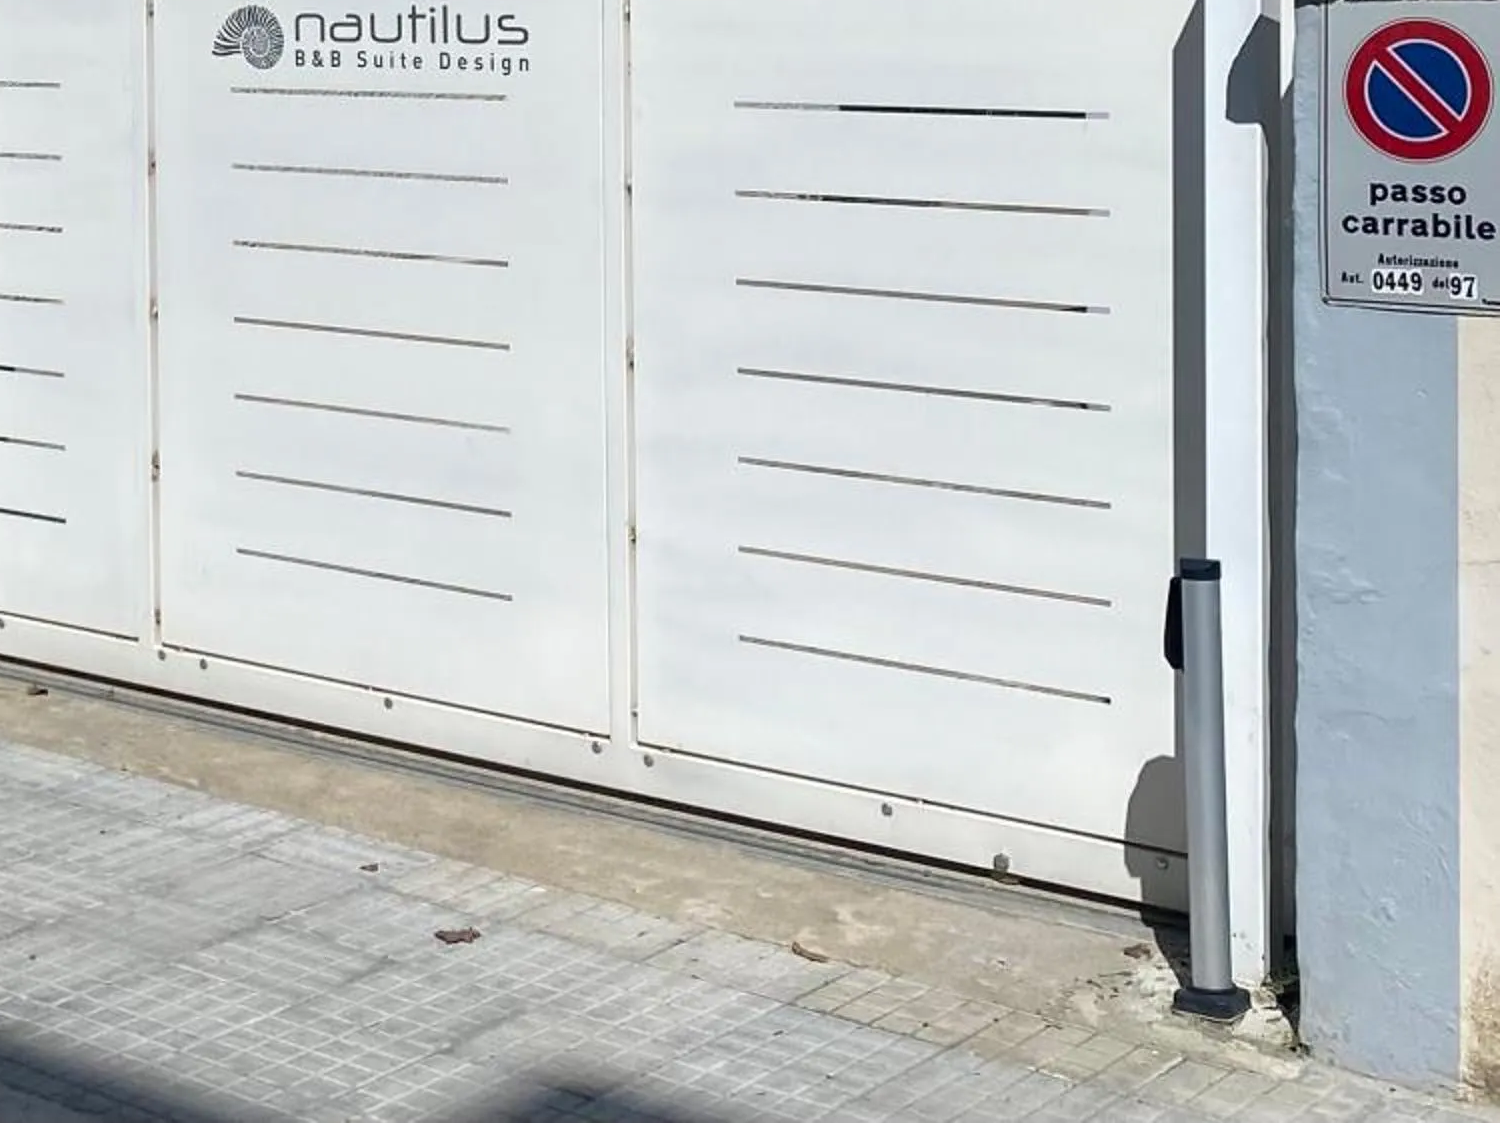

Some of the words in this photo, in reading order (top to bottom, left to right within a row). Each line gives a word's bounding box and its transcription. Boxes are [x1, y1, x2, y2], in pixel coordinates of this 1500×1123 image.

[295, 5, 529, 45] nautilus
[295, 50, 341, 68] B&B
[357, 50, 423, 69] Suite
[439, 52, 529, 76] Design
[1369, 182, 1467, 206] passo
[1341, 213, 1497, 240] carrabile
[1377, 253, 1459, 269] Autorizzazione
[1373, 271, 1422, 291] 0449
[1432, 277, 1449, 289] del
[1450, 276, 1476, 298] 97
